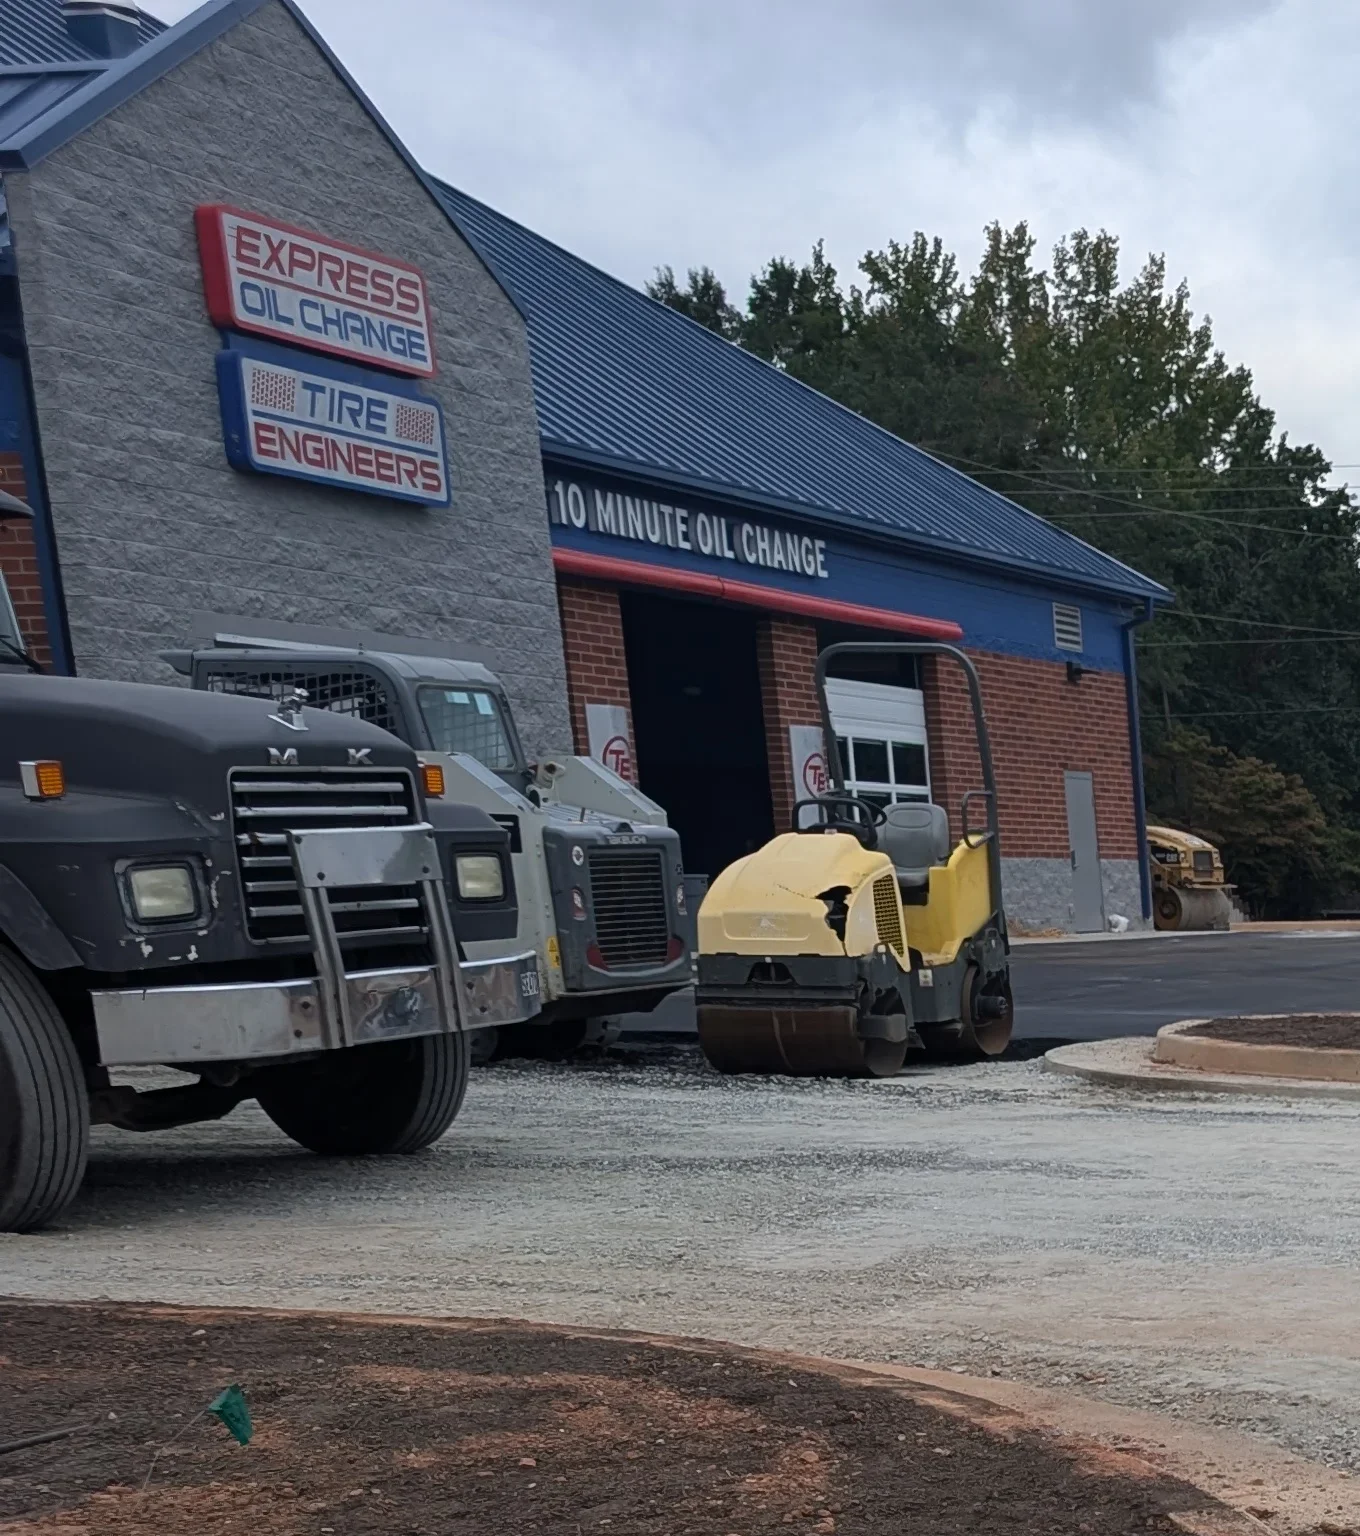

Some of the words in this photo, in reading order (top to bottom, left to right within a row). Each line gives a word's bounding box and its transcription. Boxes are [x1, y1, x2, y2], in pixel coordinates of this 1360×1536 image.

[235, 225, 420, 315] EXPRESS
[240, 281, 294, 326] OIL
[299, 298, 428, 363] CHANGE
[302, 380, 389, 434] TIRE
[254, 421, 442, 492] ENGINEERS
[554, 480, 586, 528] 10
[594, 488, 692, 551] MINUTE
[696, 512, 735, 559] OIL
[741, 522, 829, 578] CHANGE
